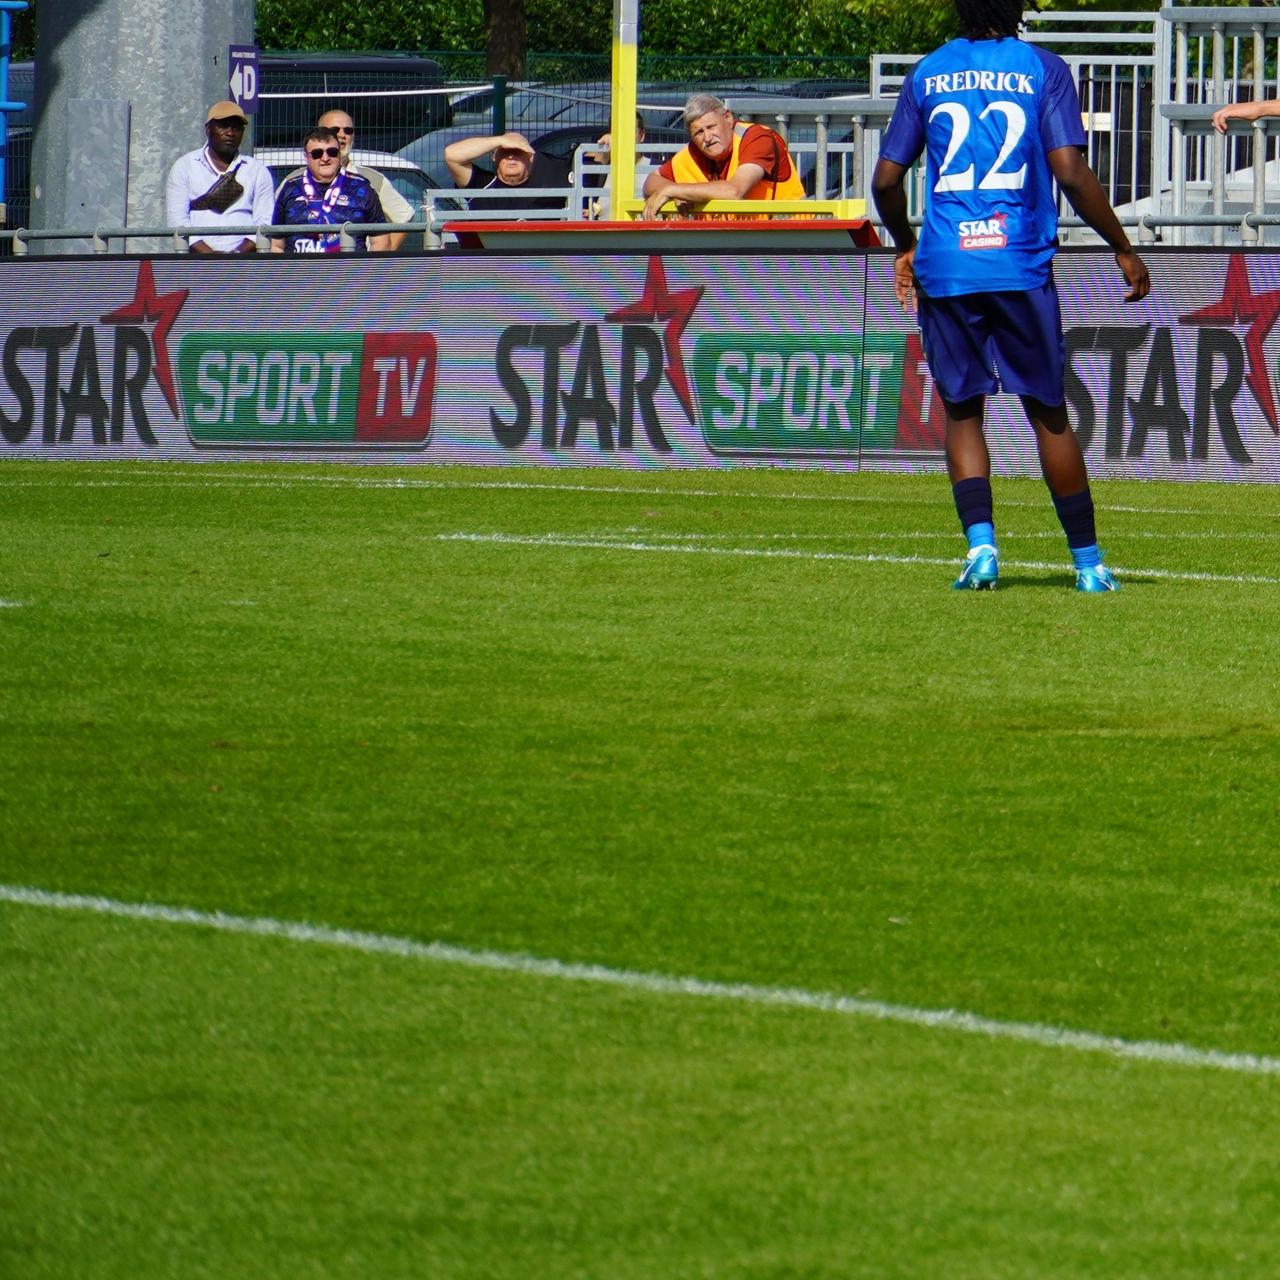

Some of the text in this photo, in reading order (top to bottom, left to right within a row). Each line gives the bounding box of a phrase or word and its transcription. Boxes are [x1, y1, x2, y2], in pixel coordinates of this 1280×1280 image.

[243, 65, 256, 100] D
[924, 70, 1035, 97] FREDRICK
[928, 100, 1028, 193] 22
[959, 220, 1003, 236] STAR
[963, 235, 1004, 248] CASINO
[0, 324, 427, 447] STAR SPORT TV
[489, 323, 675, 453] STAR
[712, 351, 888, 433] SPORT
[1064, 323, 1252, 463] STAR
